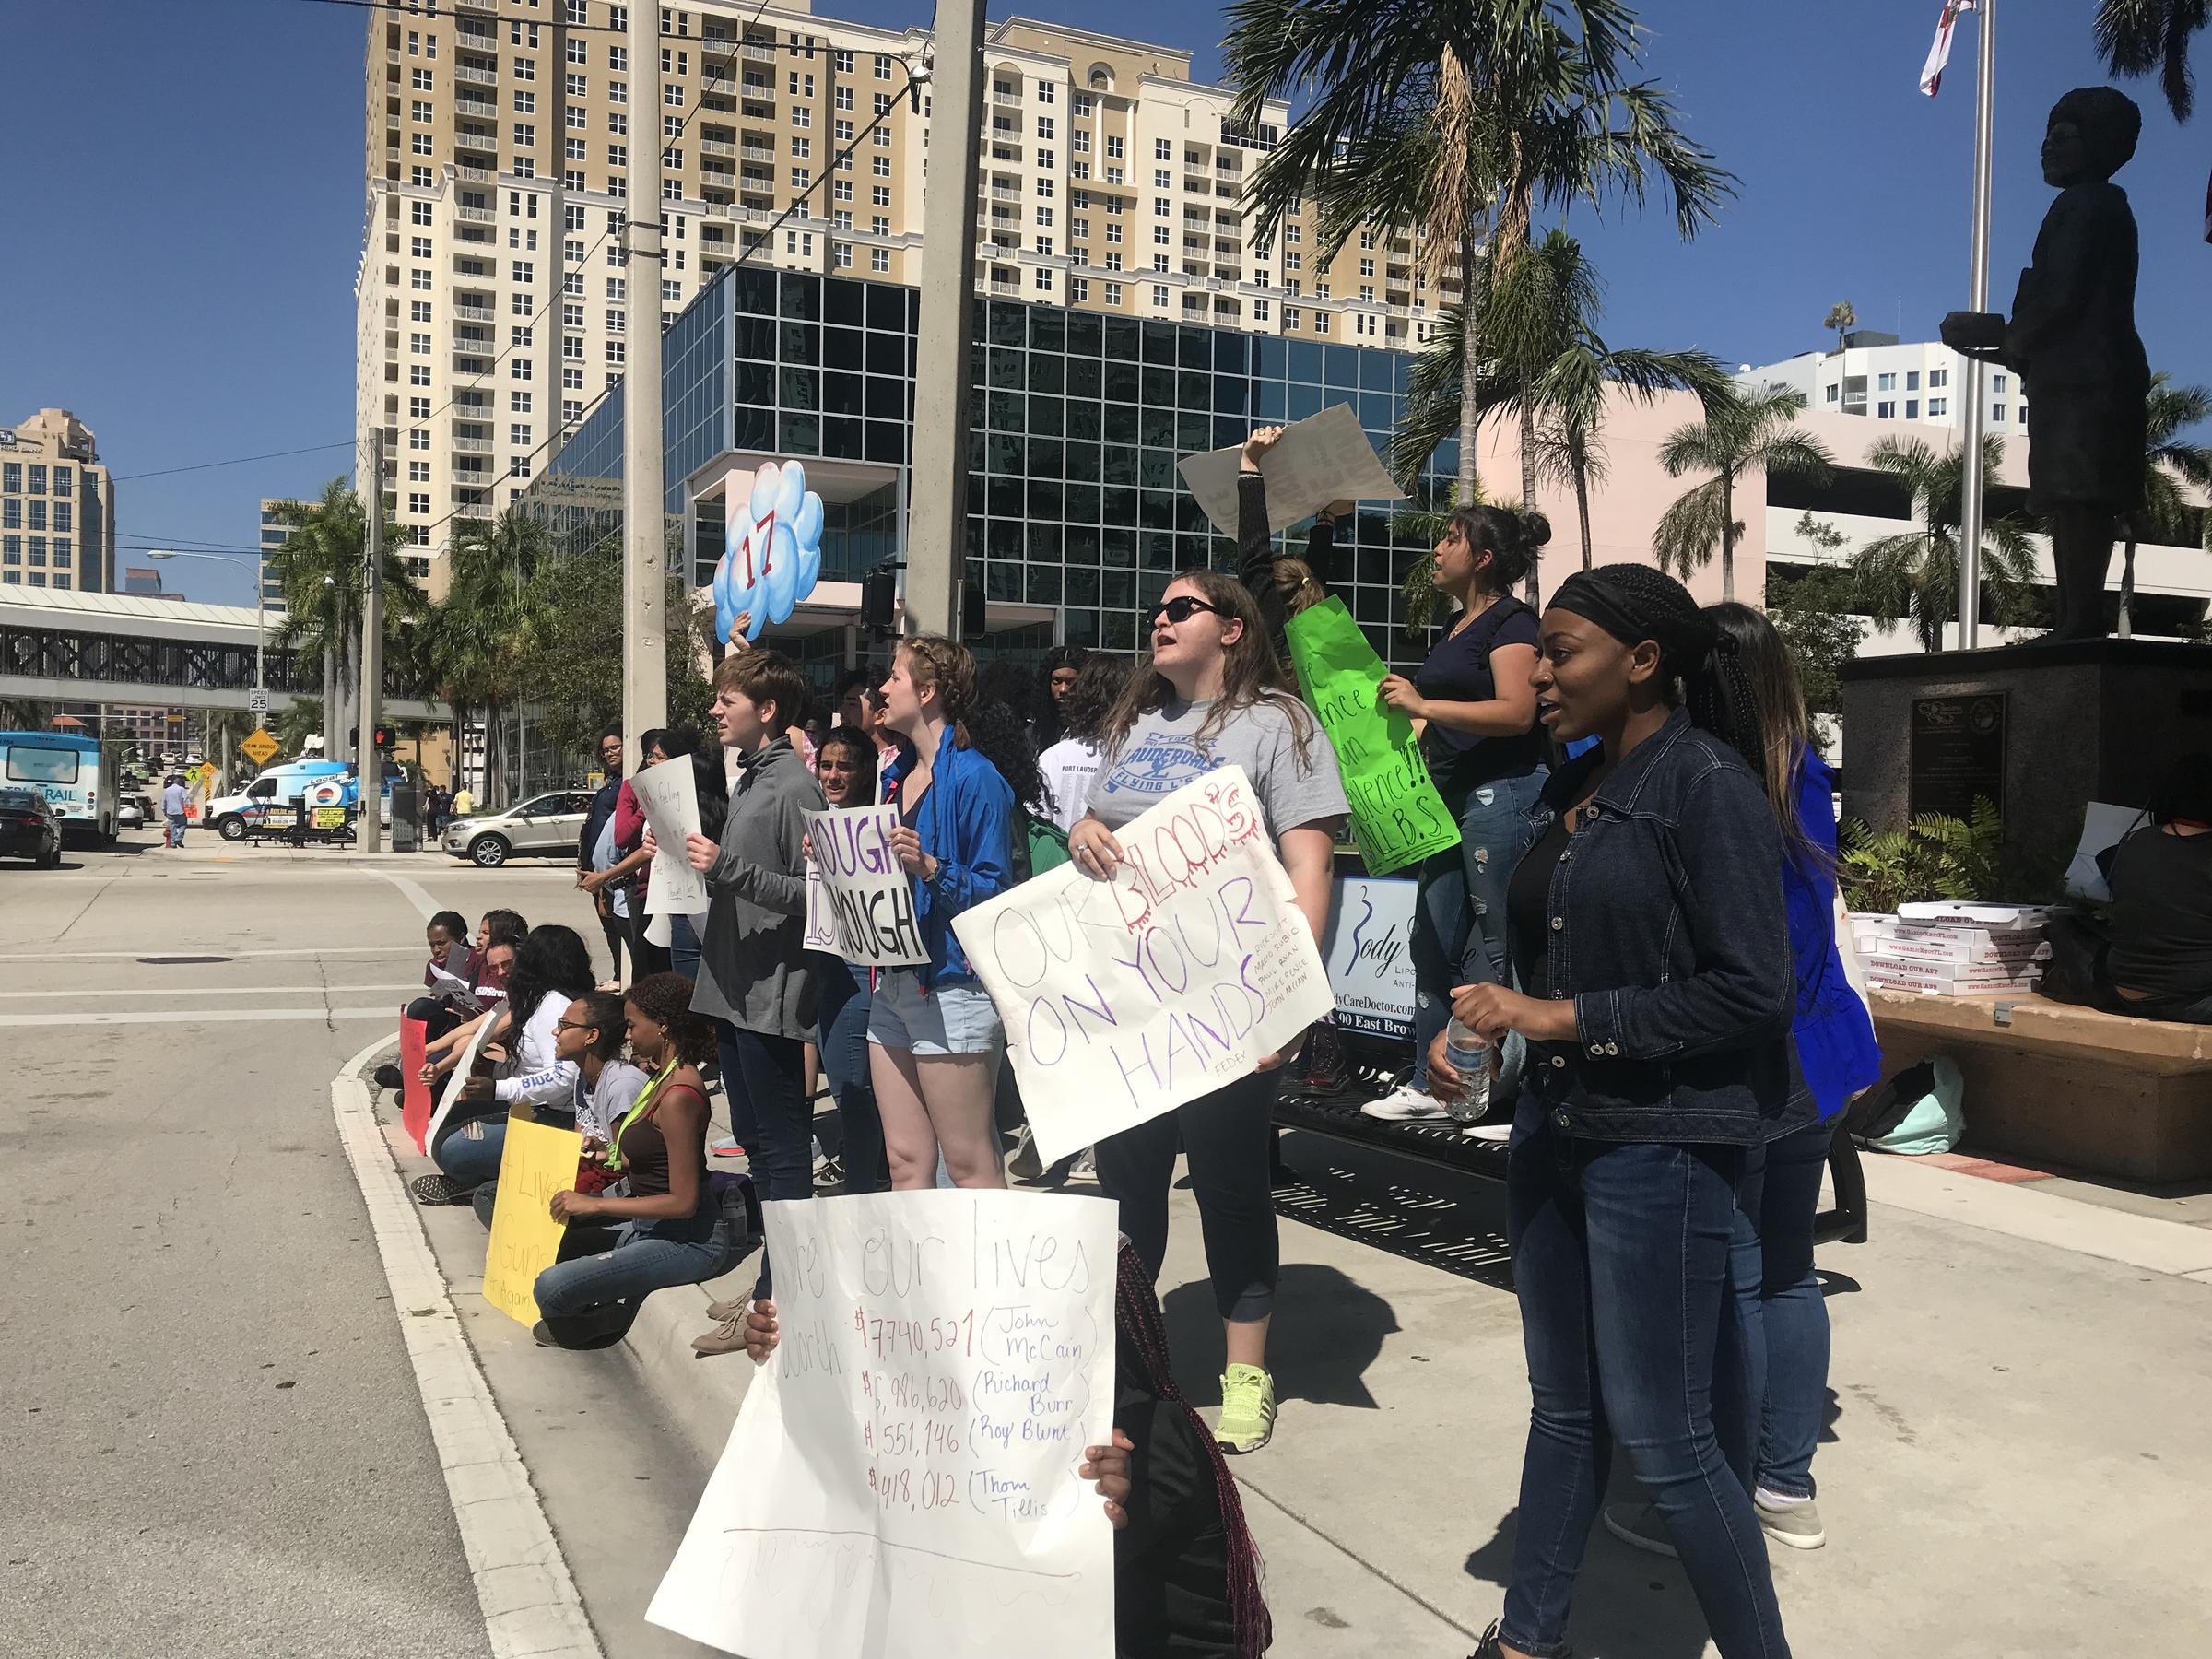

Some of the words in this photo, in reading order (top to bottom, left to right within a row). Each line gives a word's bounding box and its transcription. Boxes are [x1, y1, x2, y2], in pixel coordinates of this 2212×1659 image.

[741, 509, 775, 590] 17
[251, 700, 267, 709] 25
[1117, 747, 1226, 772] LAUDERDALE
[310, 774, 338, 784] Local
[1114, 772, 1163, 791] FLYING
[45, 788, 76, 801] RAIL
[804, 813, 903, 877] NOUGH
[994, 877, 1123, 989] OUR
[1278, 944, 1299, 966] RYAN
[1028, 974, 1117, 1066] ON
[1112, 877, 1267, 1002] YOUR
[1870, 960, 1908, 971] DOWNLOAD
[1909, 965, 1924, 973] OUR
[1869, 975, 1907, 986] DOWNLOAD
[1266, 994, 1285, 1014] JOHN
[1110, 953, 1265, 1109] HANDS
[1356, 1016, 1382, 1030] East
[522, 1073, 555, 1089] 2018
[973, 1199, 1091, 1295] lives
[500, 1279, 531, 1312] Again
